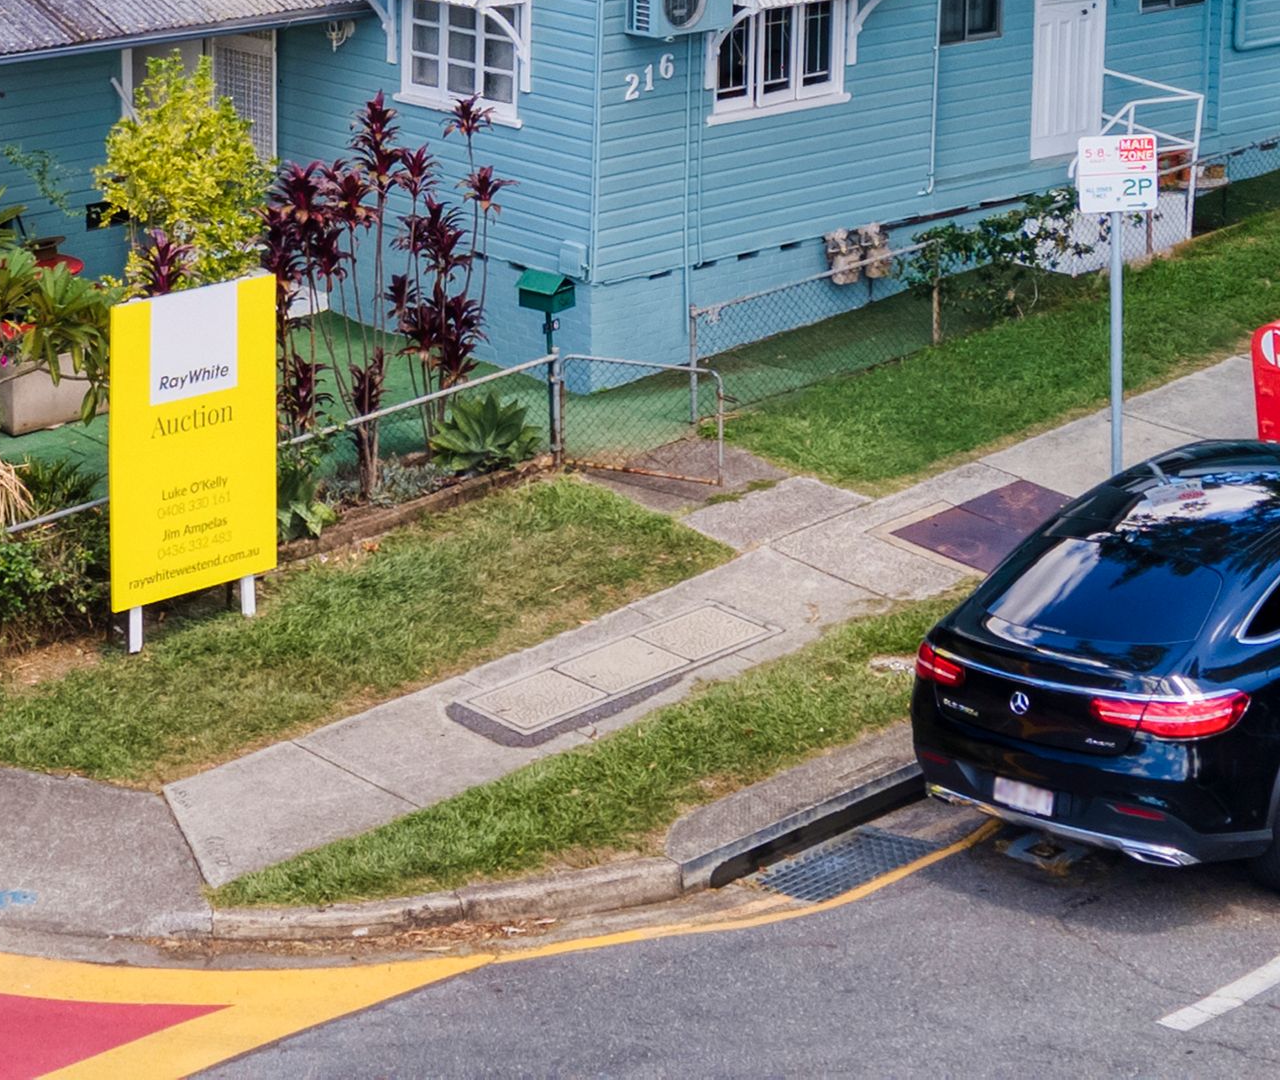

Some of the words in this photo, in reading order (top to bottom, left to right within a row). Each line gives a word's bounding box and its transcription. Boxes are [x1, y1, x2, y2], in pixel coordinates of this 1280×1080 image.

[625, 54, 674, 100] 216
[1121, 139, 1153, 150] MAIL
[1121, 150, 1153, 161] ZONE
[1122, 178, 1153, 196] 2P
[151, 405, 233, 439] Auction
[162, 486, 188, 501] Luke
[190, 476, 228, 494] O'Kelly
[162, 529, 180, 542] Jim
[183, 517, 228, 536] Ampelas
[129, 547, 260, 590] raywhitewestend.com.au
